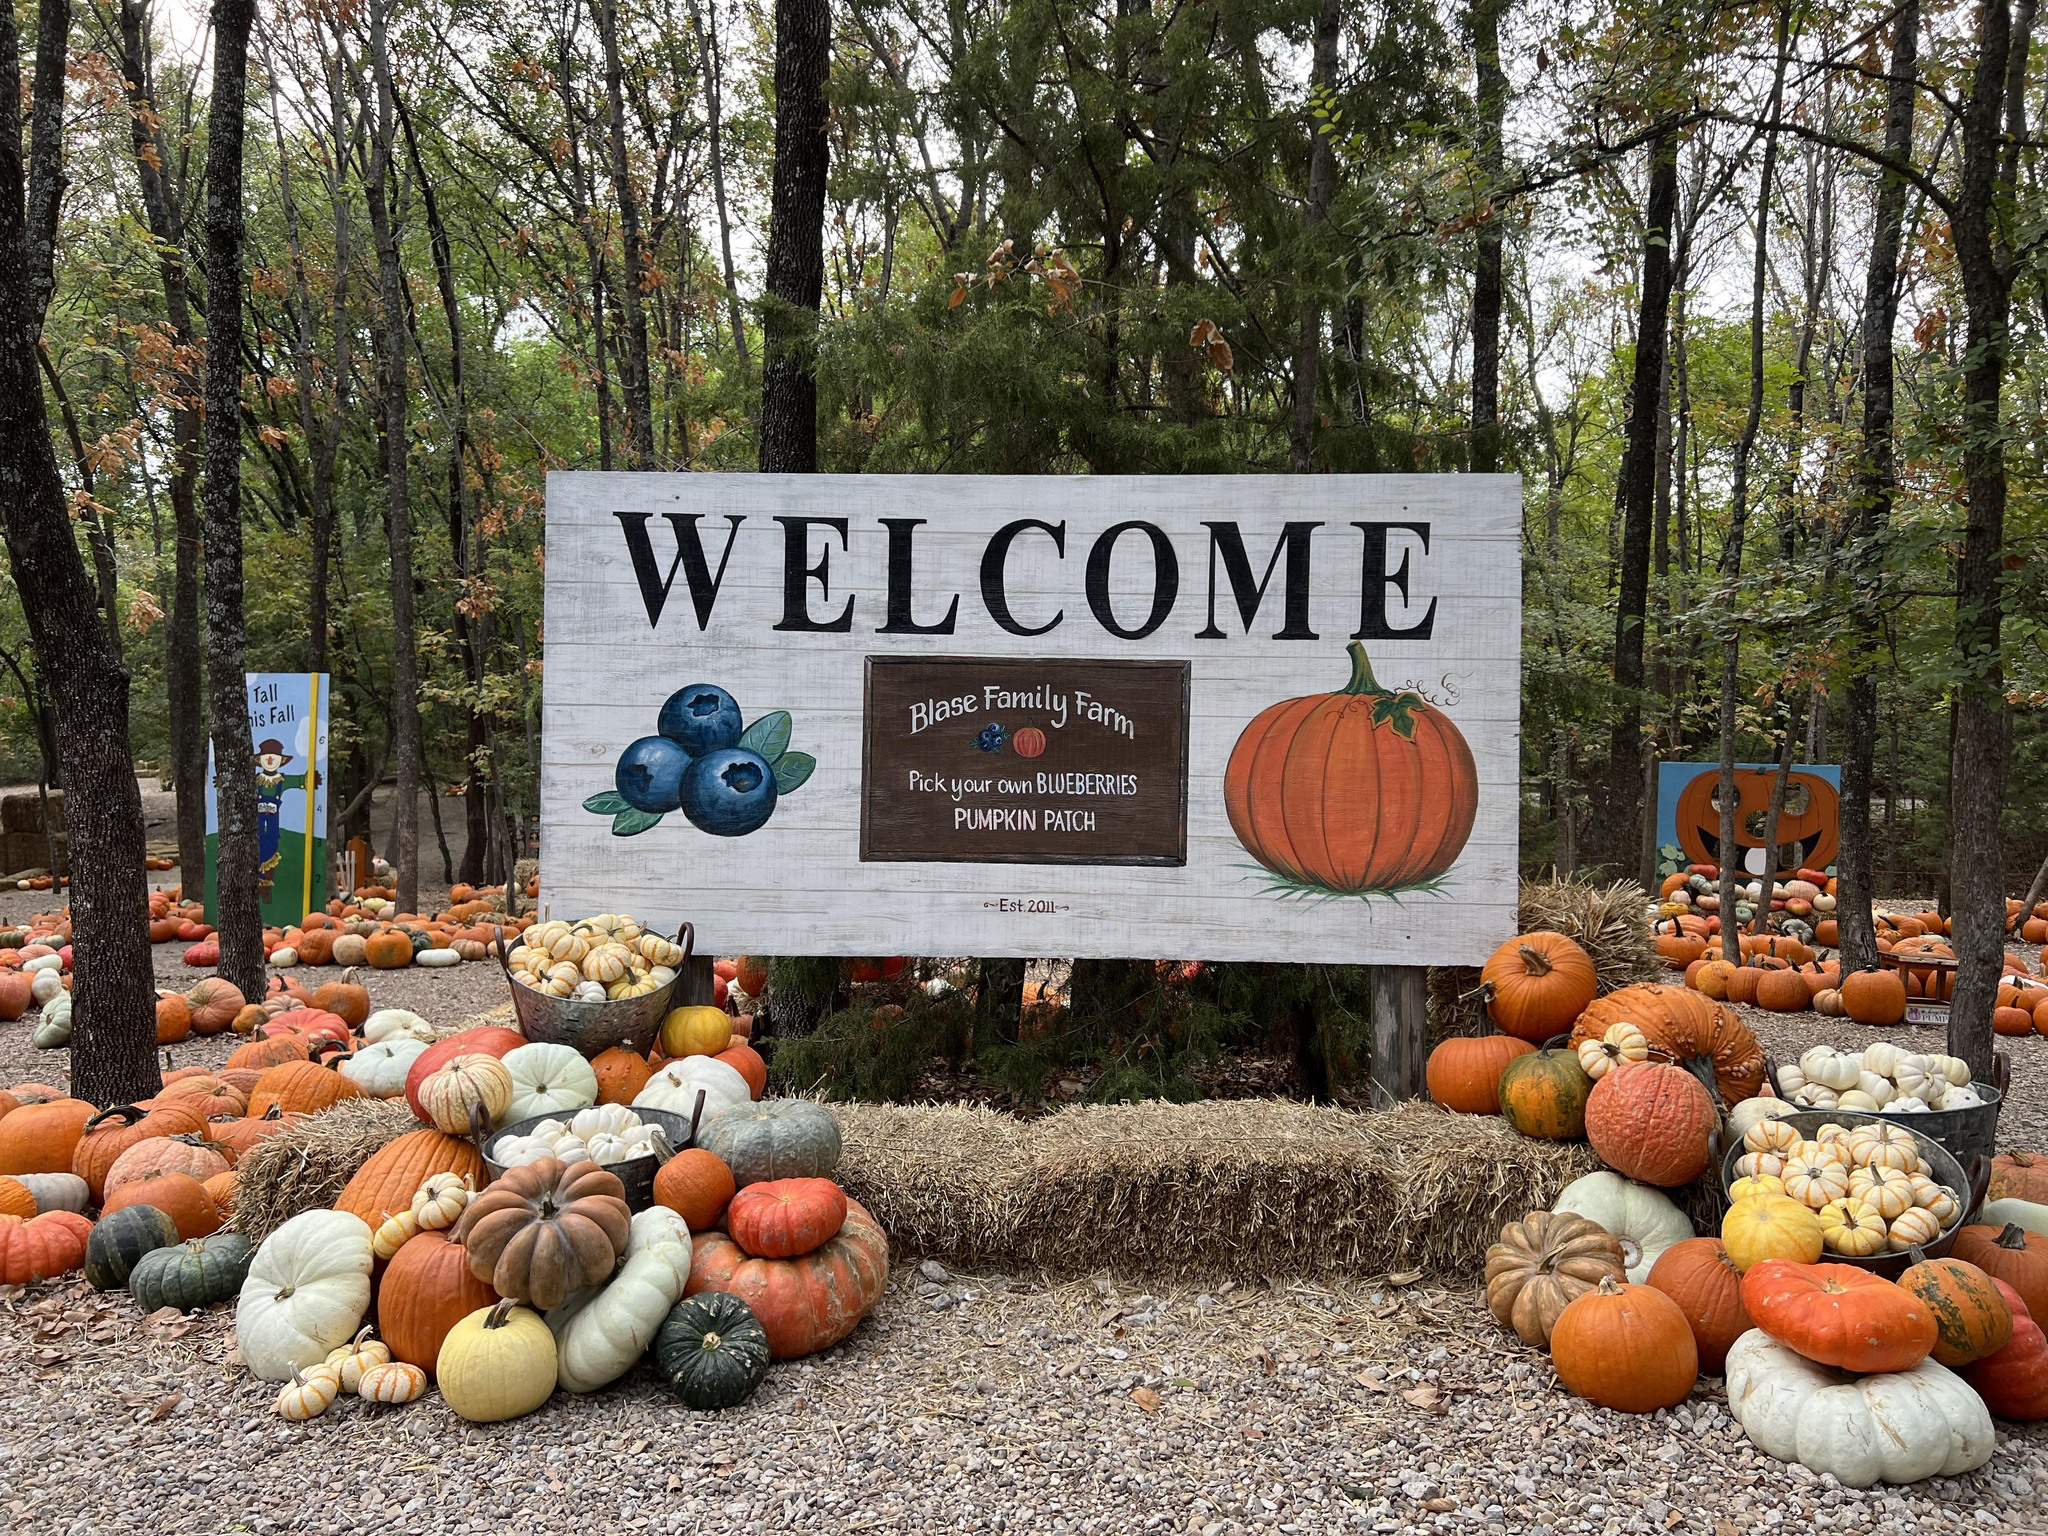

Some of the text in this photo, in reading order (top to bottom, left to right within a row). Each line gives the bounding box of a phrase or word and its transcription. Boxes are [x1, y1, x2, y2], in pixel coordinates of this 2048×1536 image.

[612, 511, 1438, 641] WELCOME
[253, 683, 278, 703] Tall
[249, 704, 295, 727] is Fall
[909, 683, 1135, 740] Blase Family Farm
[318, 735, 327, 745] 6
[909, 769, 1138, 802] Pick your own BLUEBERRIES
[954, 807, 1096, 832] PUMPKIN PATCH
[999, 898, 1056, 914] Est. 2011
